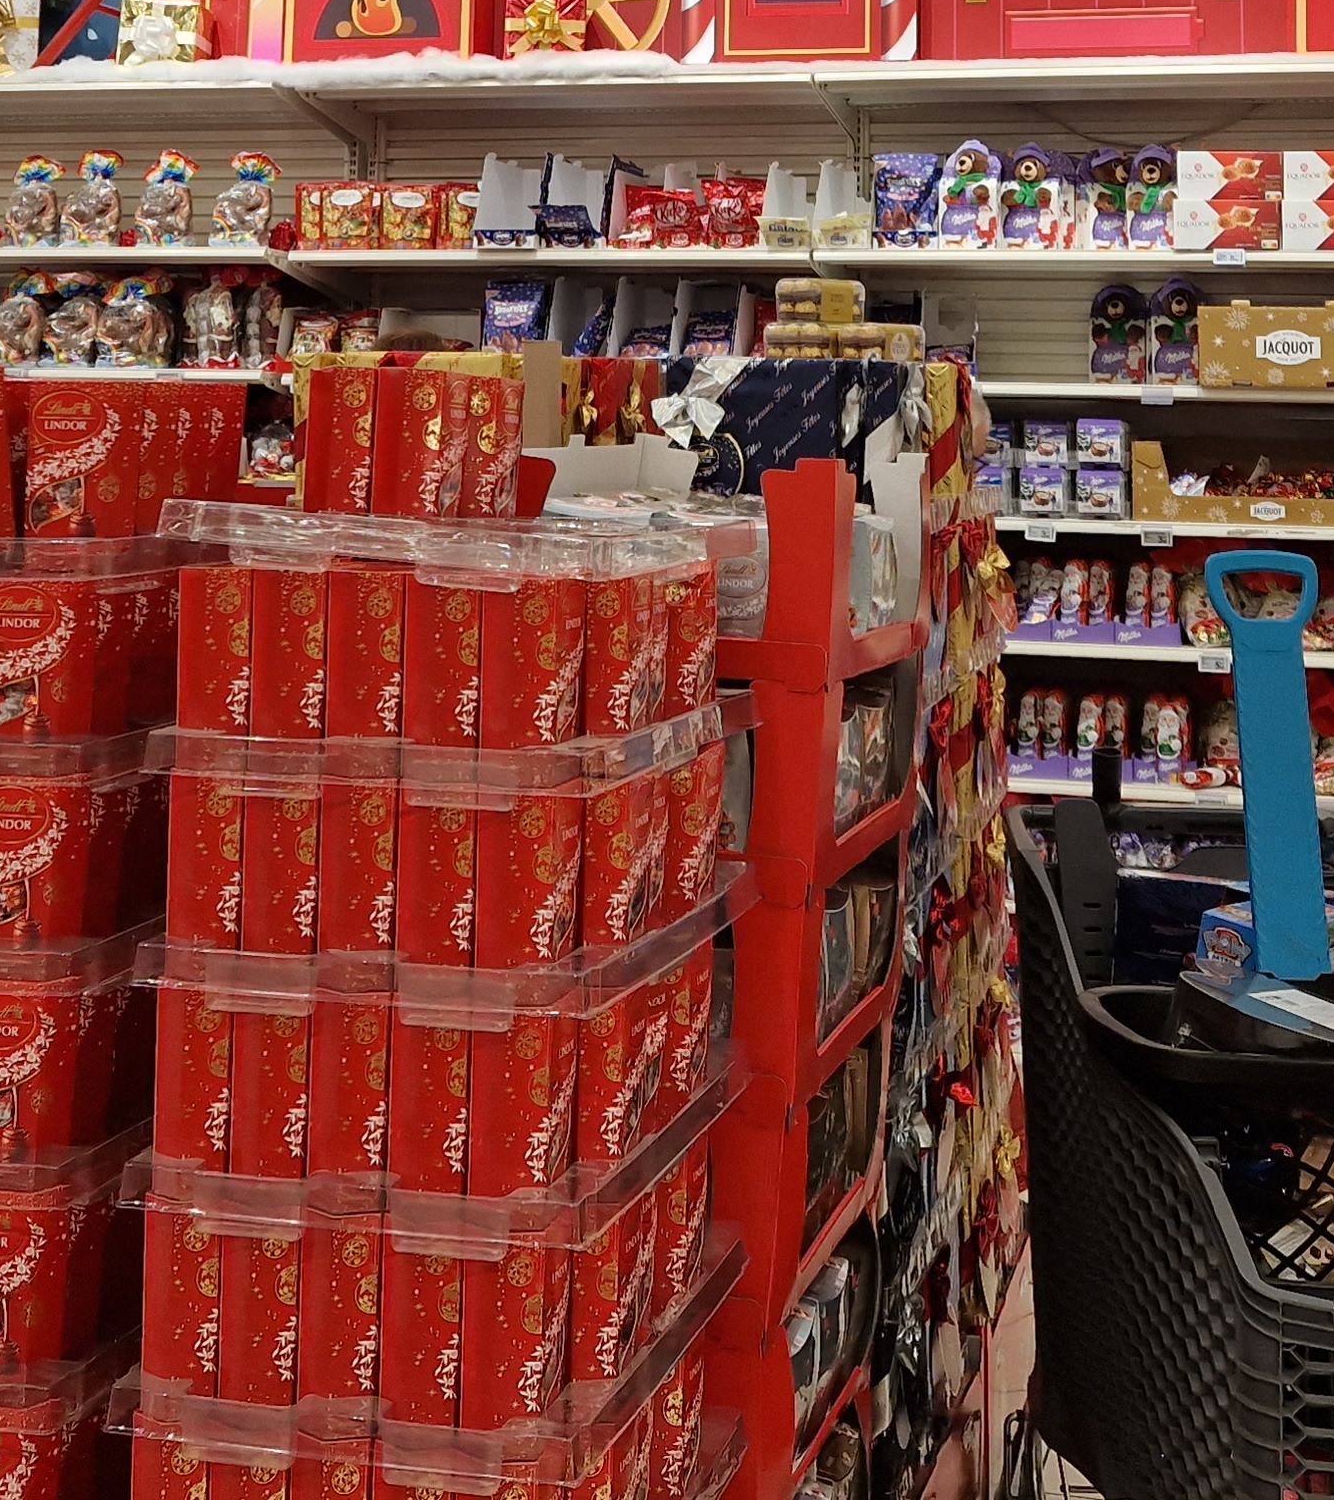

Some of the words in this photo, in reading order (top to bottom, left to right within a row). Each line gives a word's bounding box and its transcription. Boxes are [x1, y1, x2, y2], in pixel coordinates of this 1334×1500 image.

[951, 212, 977, 227] Milka
[1013, 216, 1038, 229] Milka
[1140, 219, 1165, 232] Milka
[1261, 340, 1315, 356] JACQUOT
[1101, 353, 1125, 364] Milka
[1165, 351, 1190, 363] Milka
[44, 419, 88, 431] LINDOR
[773, 431, 803, 463] Joyeuses
[1253, 506, 1282, 516] JACQUOT
[1054, 628, 1078, 640] Milka
[1117, 630, 1142, 643] Milka
[1009, 762, 1033, 775] Milka
